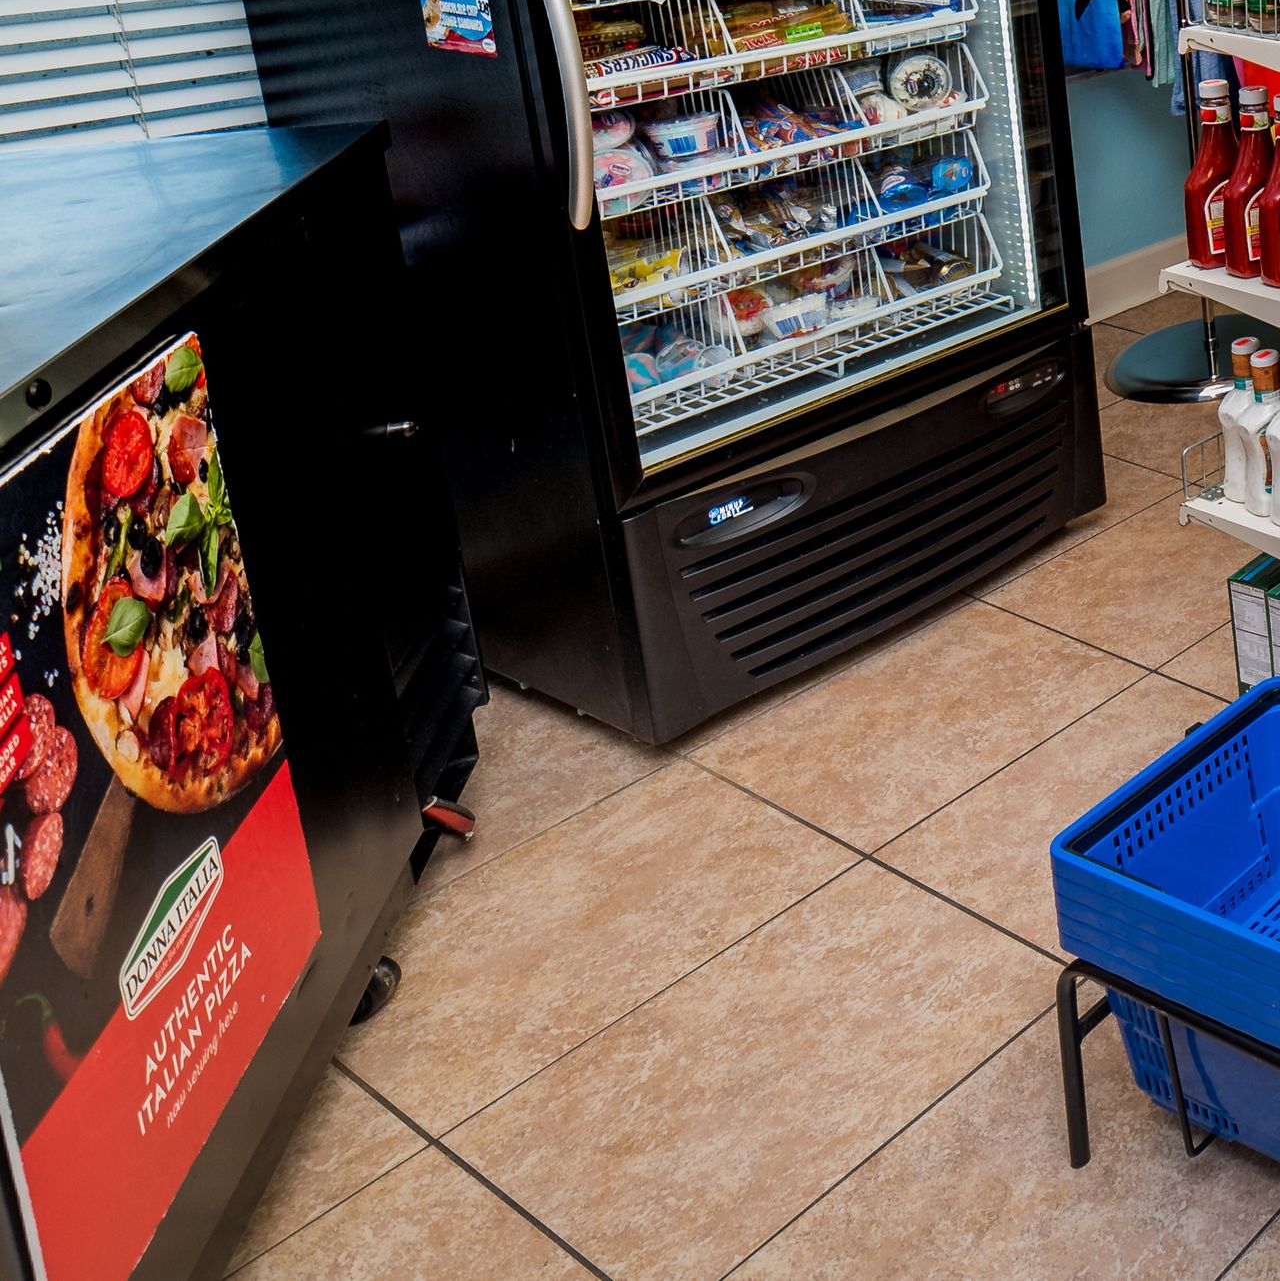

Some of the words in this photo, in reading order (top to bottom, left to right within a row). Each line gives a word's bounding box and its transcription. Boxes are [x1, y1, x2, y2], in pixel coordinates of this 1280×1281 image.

[125, 918, 176, 1001] DONNA
[176, 855, 220, 925] ITALIA
[144, 923, 235, 1086] AUTHENTIC
[136, 1015, 204, 1137] ITALIAN
[204, 941, 252, 1023] PIZZA
[167, 1091, 187, 1129] now
[218, 1000, 239, 1036] here
